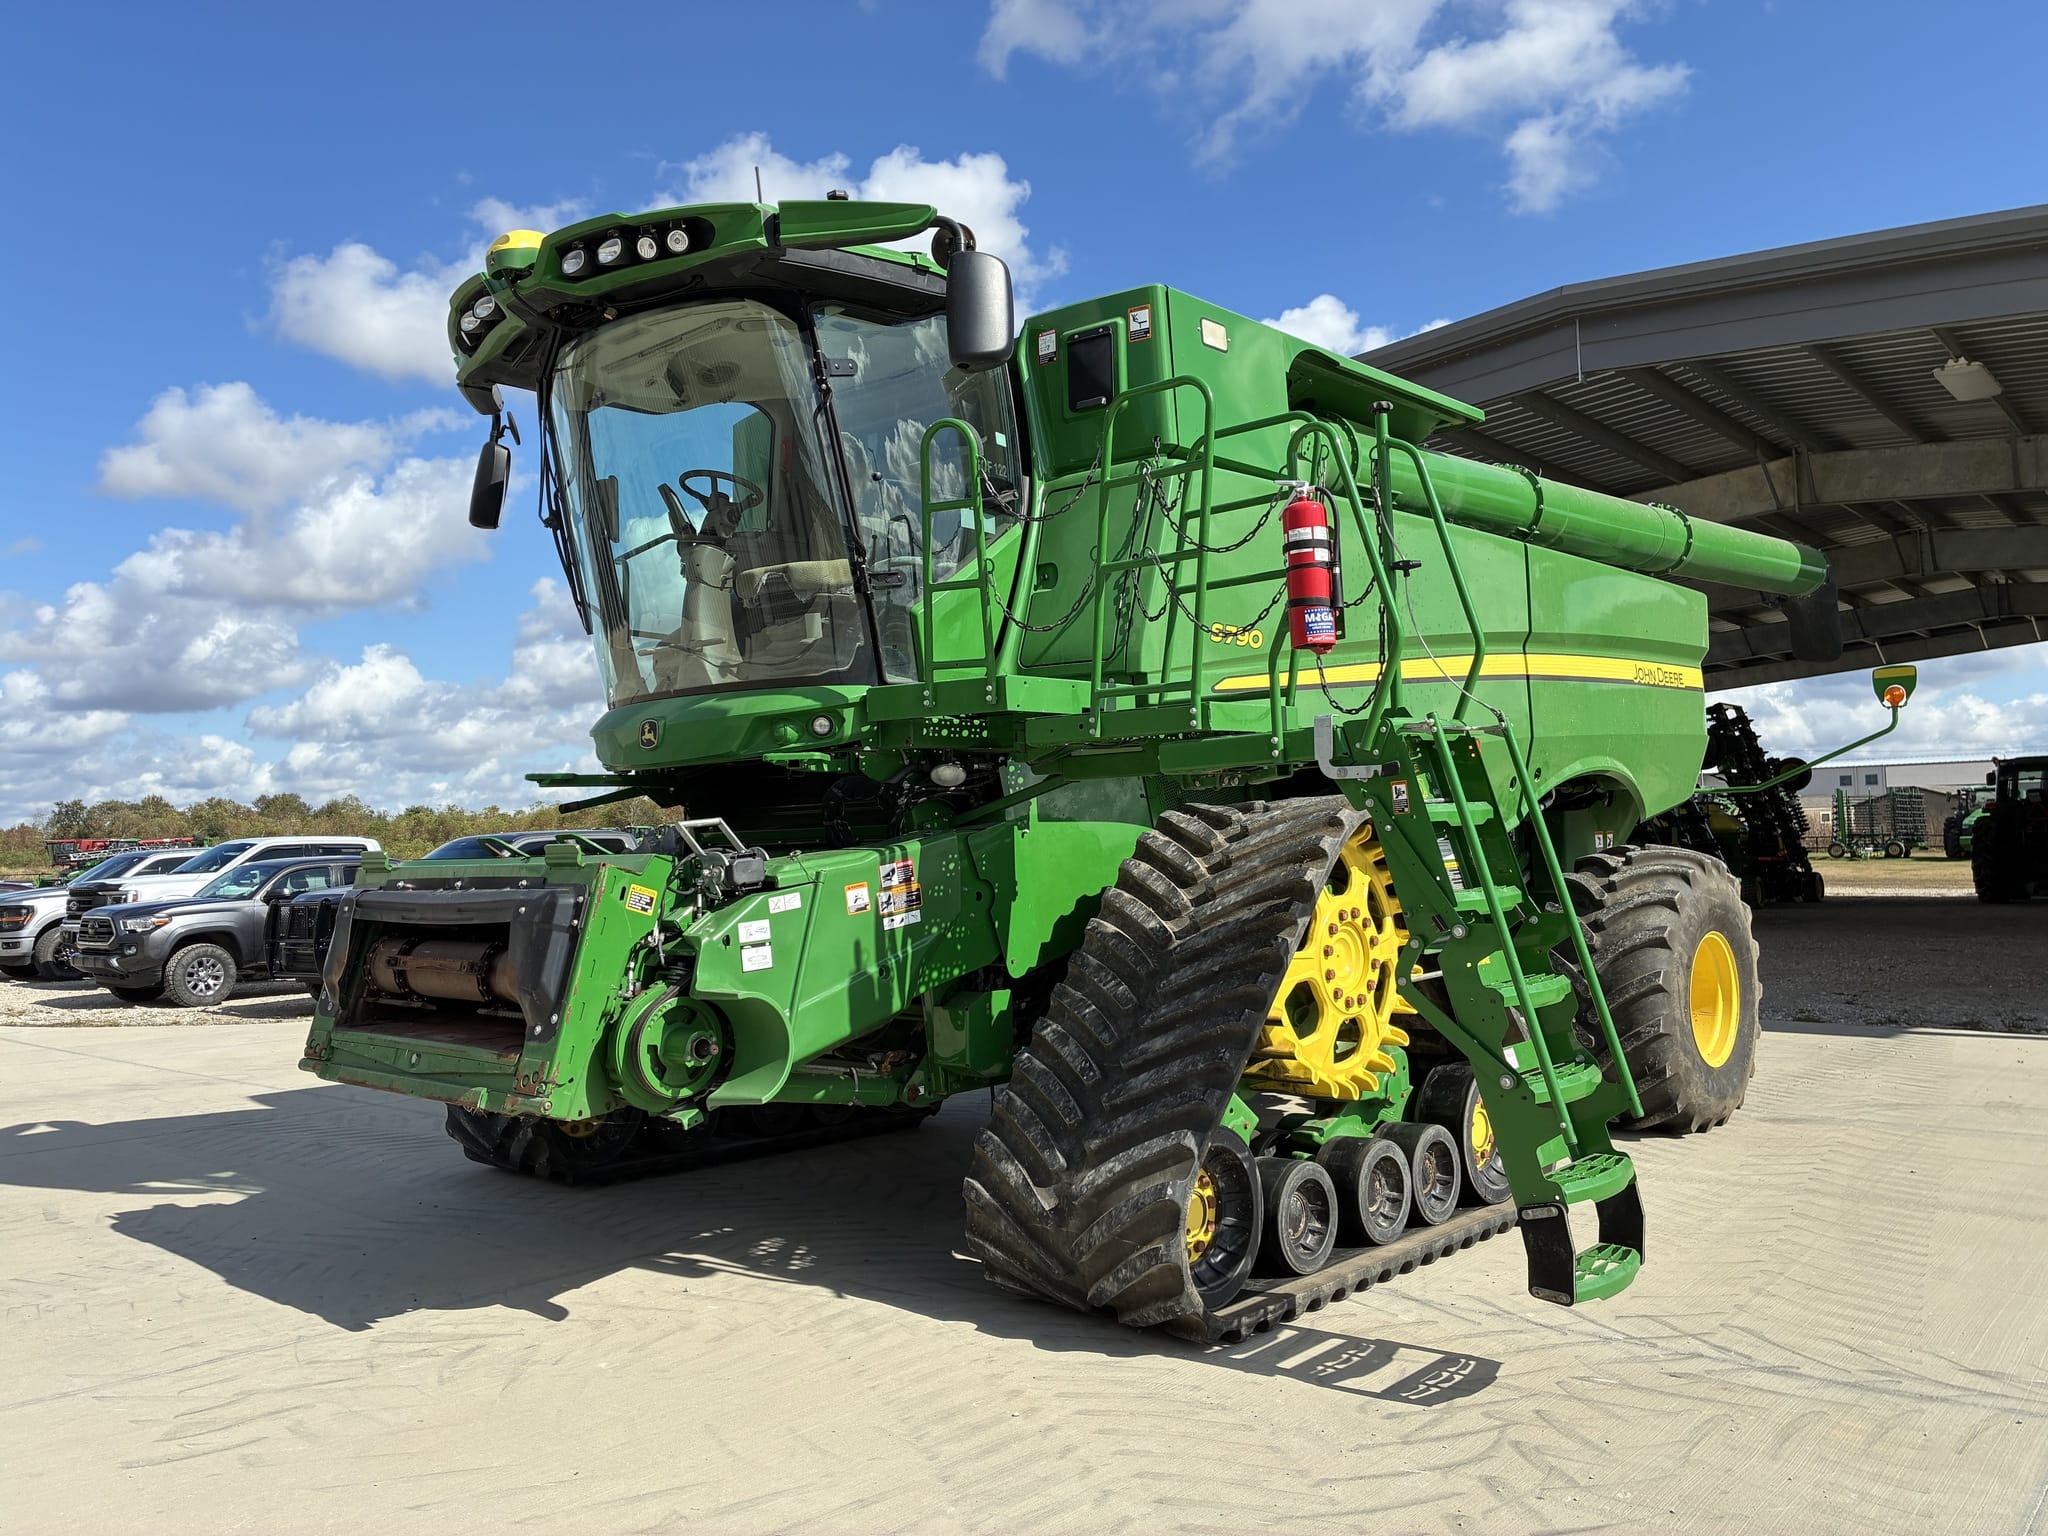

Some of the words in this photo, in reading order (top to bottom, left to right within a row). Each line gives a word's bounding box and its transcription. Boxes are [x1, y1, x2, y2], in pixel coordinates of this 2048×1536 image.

[1210, 622, 1264, 650] S790
[1633, 663, 1656, 682] JOHN
[1657, 667, 1685, 686] DEERE
